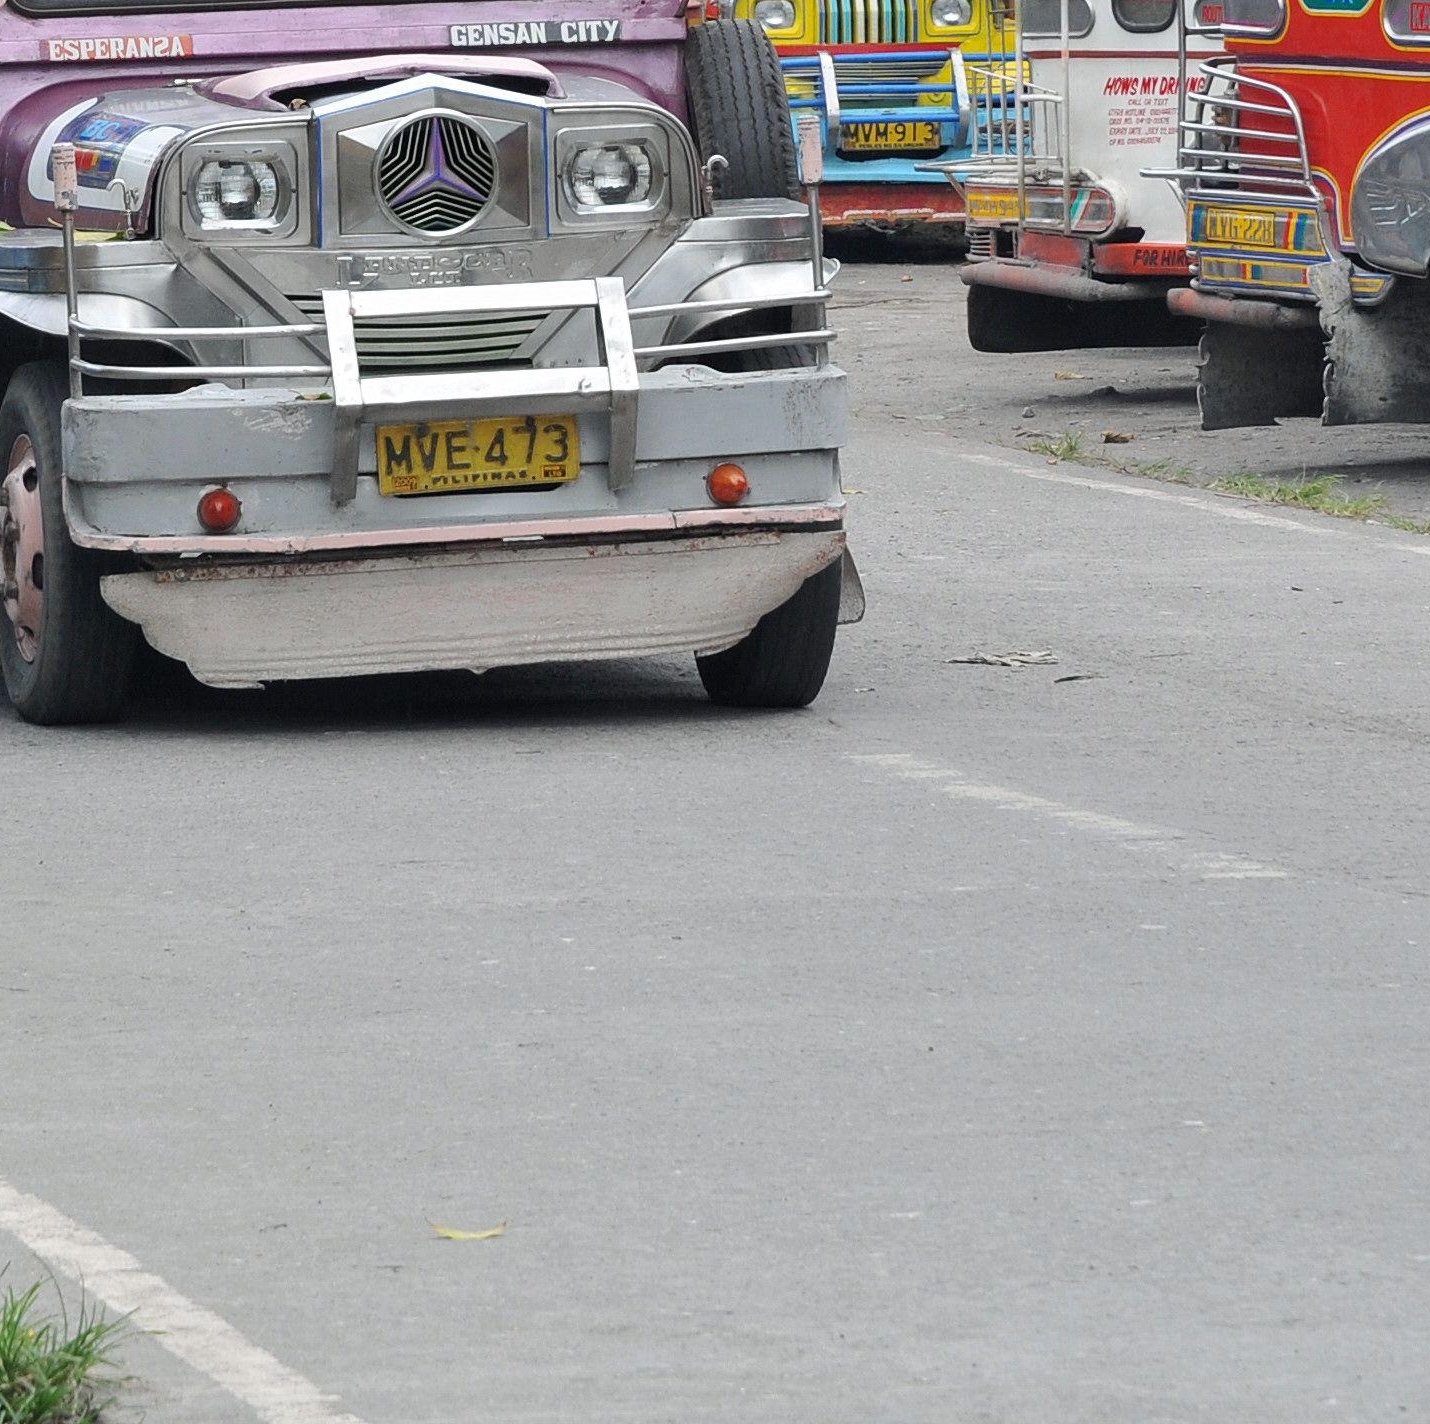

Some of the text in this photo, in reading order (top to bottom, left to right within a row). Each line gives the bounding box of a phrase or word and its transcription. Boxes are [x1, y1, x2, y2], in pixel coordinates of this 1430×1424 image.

[450, 19, 619, 46] GENSAN CITY
[1140, 76, 1161, 95] MY
[1134, 249, 1158, 266] FOR
[432, 470, 528, 485] PILIPINAS
